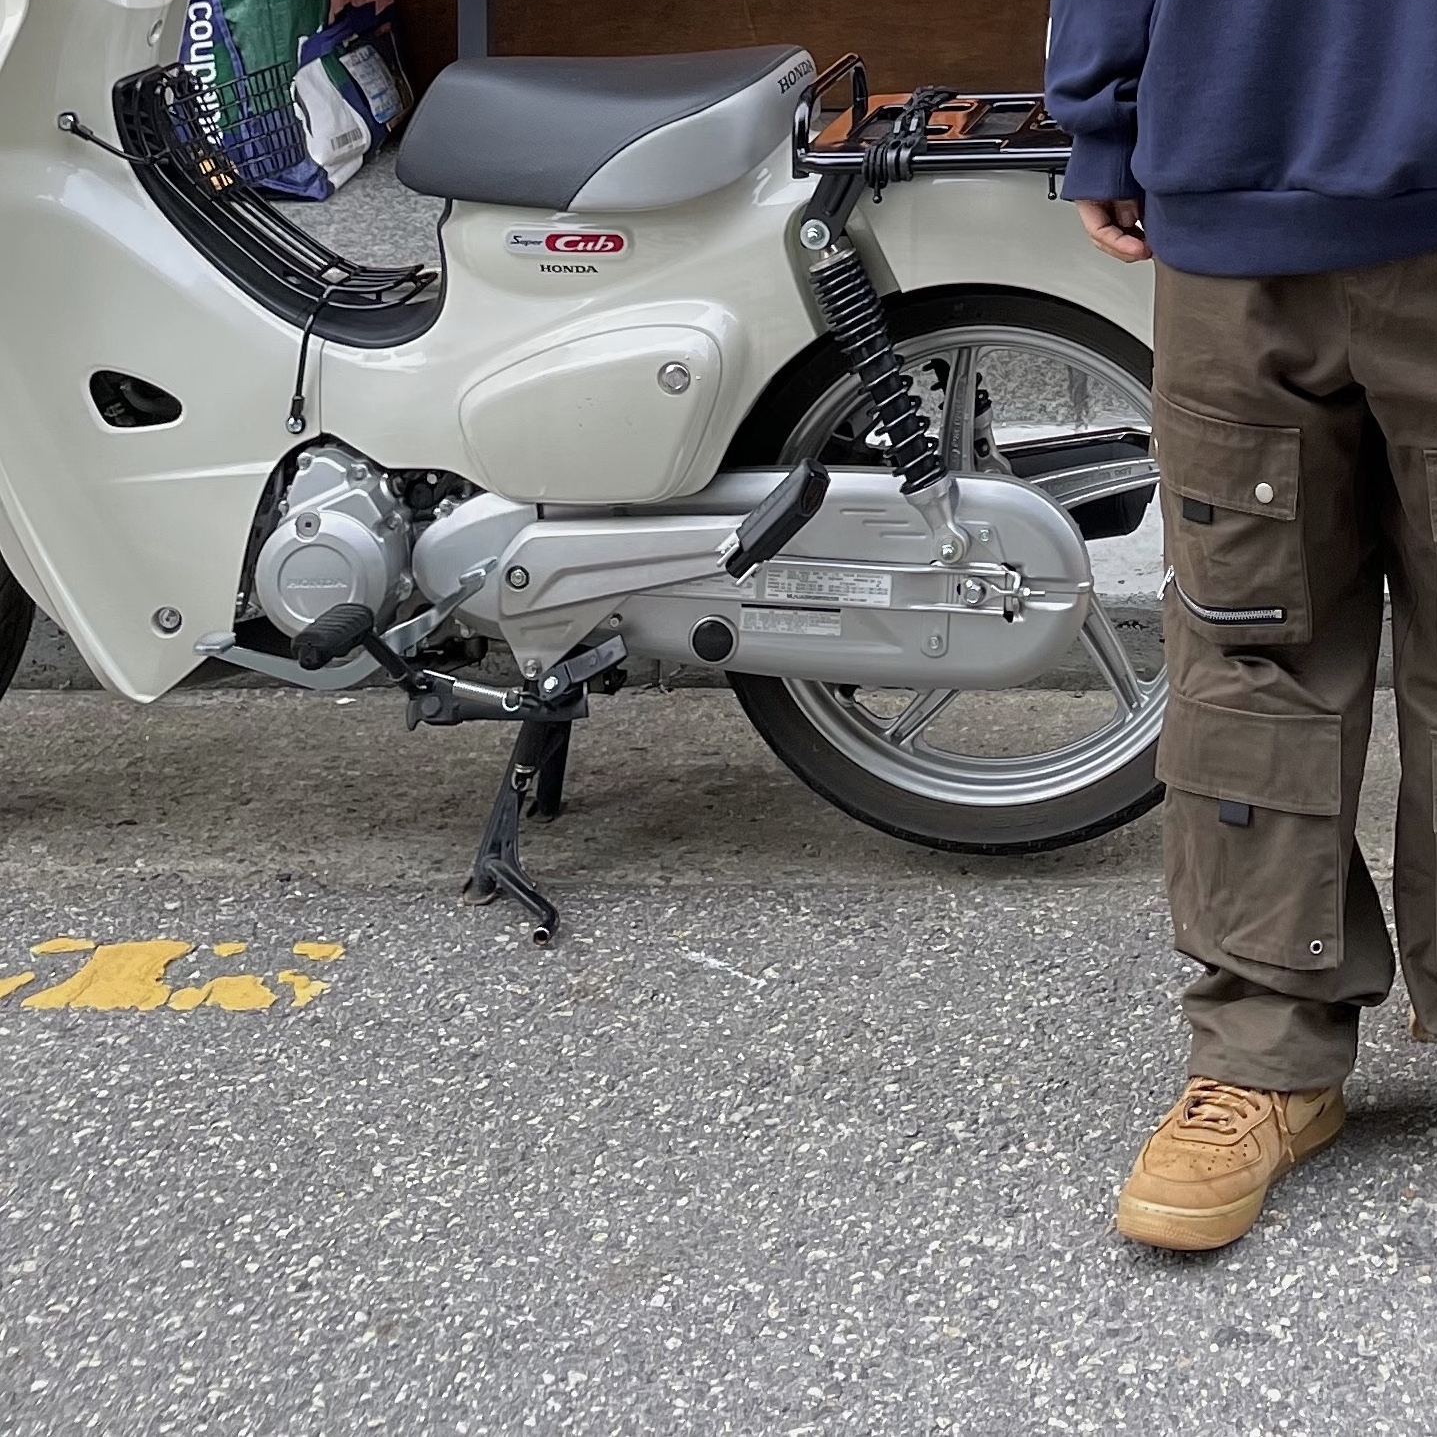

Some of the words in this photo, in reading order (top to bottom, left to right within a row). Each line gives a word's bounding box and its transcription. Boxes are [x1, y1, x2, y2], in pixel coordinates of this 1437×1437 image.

[777, 59, 814, 94] HONDA
[553, 235, 615, 252] Cub
[540, 264, 599, 274] HONDA
